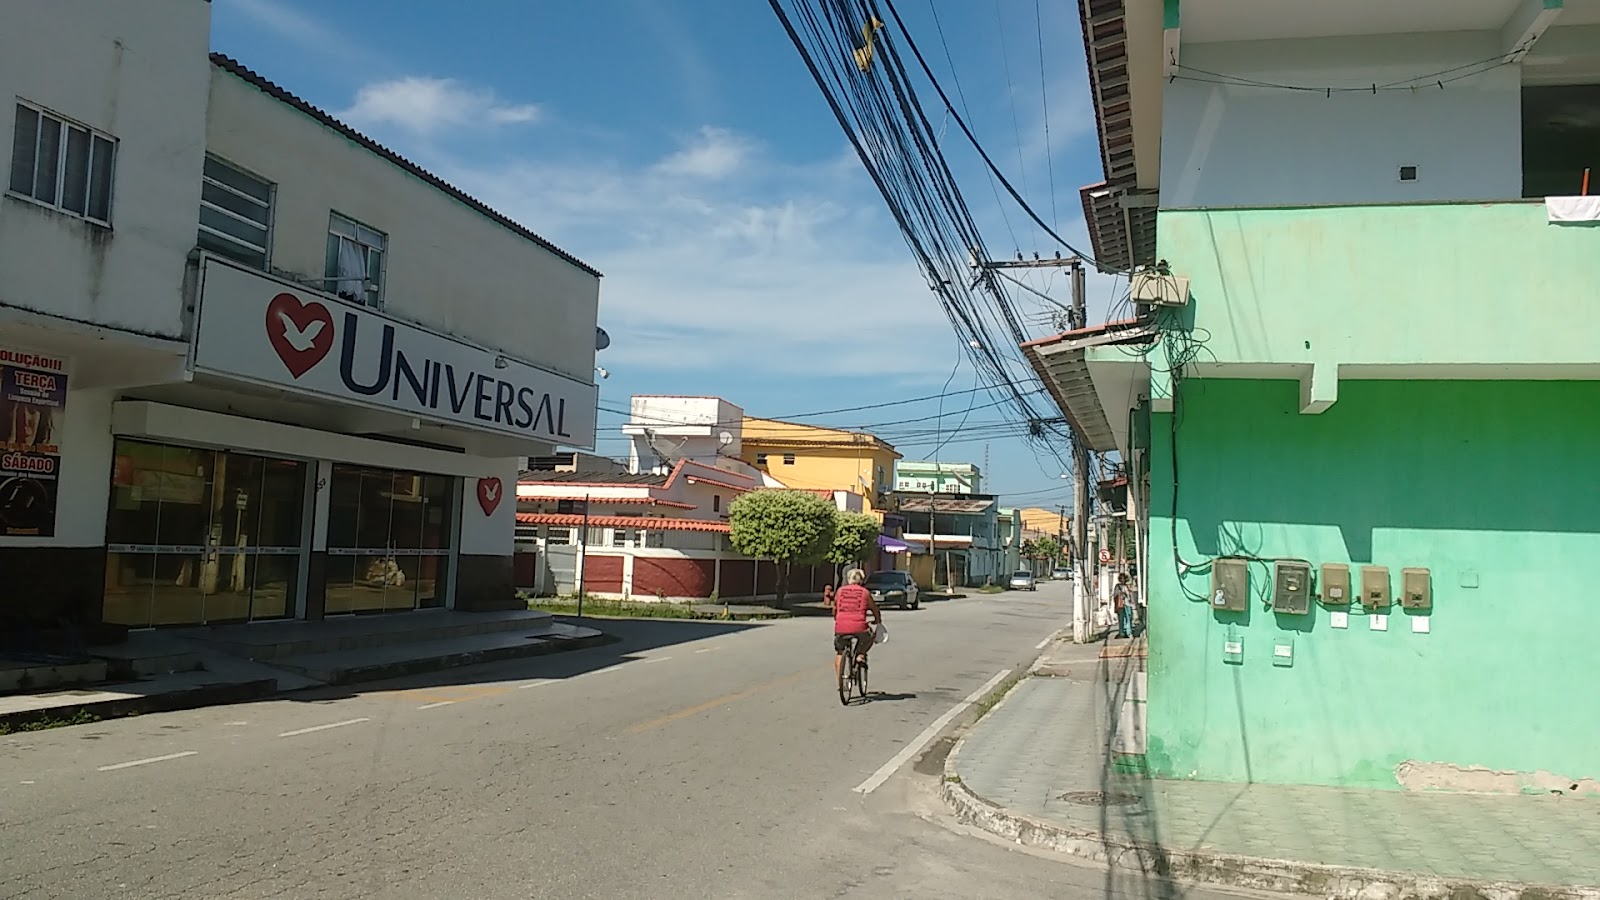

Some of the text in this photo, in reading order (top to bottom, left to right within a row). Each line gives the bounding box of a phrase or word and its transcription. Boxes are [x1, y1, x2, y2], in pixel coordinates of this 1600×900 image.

[15, 371, 56, 391] TERÇA
[340, 312, 571, 438] UNIVERSAL
[3, 452, 53, 472] SÁBADO
